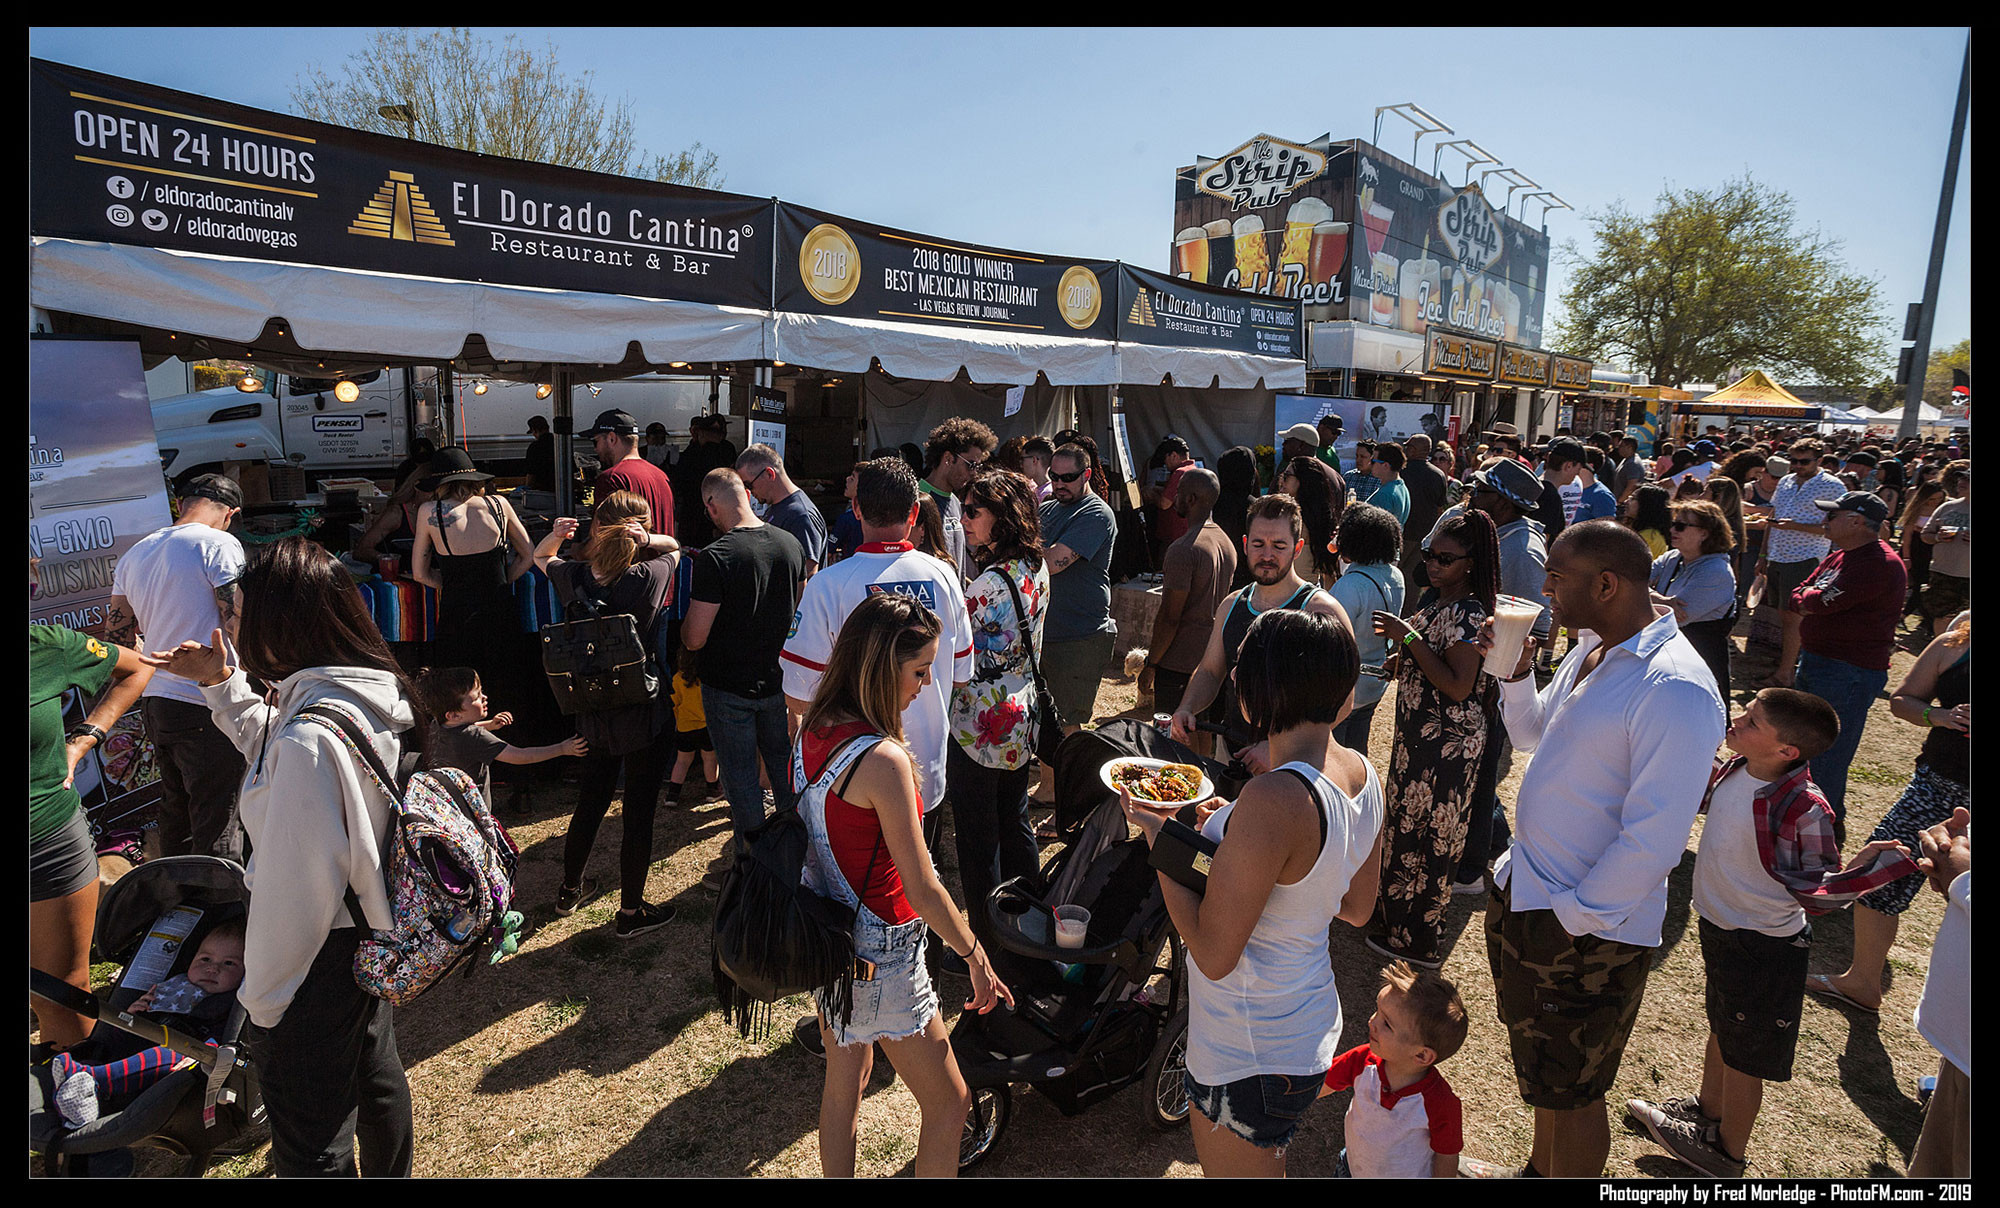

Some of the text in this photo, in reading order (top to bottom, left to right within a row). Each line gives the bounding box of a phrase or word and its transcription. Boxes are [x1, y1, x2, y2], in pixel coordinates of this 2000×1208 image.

[74, 109, 316, 184] OPEN 24 HOURS
[1252, 139, 1273, 162] The
[1206, 149, 1315, 191] Strip
[155, 183, 294, 221] eldoradocantinalv
[1231, 185, 1293, 212] Pub
[1399, 180, 1424, 202] GRAND
[453, 181, 480, 218] El
[501, 189, 611, 236] Dorado
[187, 216, 298, 249] eldoradovegas
[1446, 194, 1497, 259] Strip
[490, 232, 711, 276] Restaurant & Bar
[814, 248, 847, 280] 2018
[913, 248, 1014, 282] 2018 GOLD WINNER
[1457, 239, 1487, 275] Pub
[884, 268, 1038, 307] BEST MEXICAN RESTAURANT
[1067, 285, 1091, 309] 2018
[1282, 263, 1345, 304] Beer
[1353, 266, 1400, 297] Mixed Drinks
[919, 299, 932, 313] LAS
[934, 302, 955, 316] VEGAS
[957, 303, 980, 318] REVIEW
[981, 306, 1009, 320] JOURNAL
[1155, 291, 1164, 311] El
[1168, 294, 1202, 318] Dorado
[1250, 307, 1294, 326] OPEN 24 HOURS
[1417, 280, 1506, 338] Ice Cold Beer
[1166, 318, 1233, 338] Restaurant & Bar
[1433, 336, 1493, 376] Mixed Drinks
[1517, 354, 1531, 378] Cold
[317, 420, 359, 428] PENSKE
[31, 554, 117, 601] UISINE
[893, 583, 931, 600] SAA
